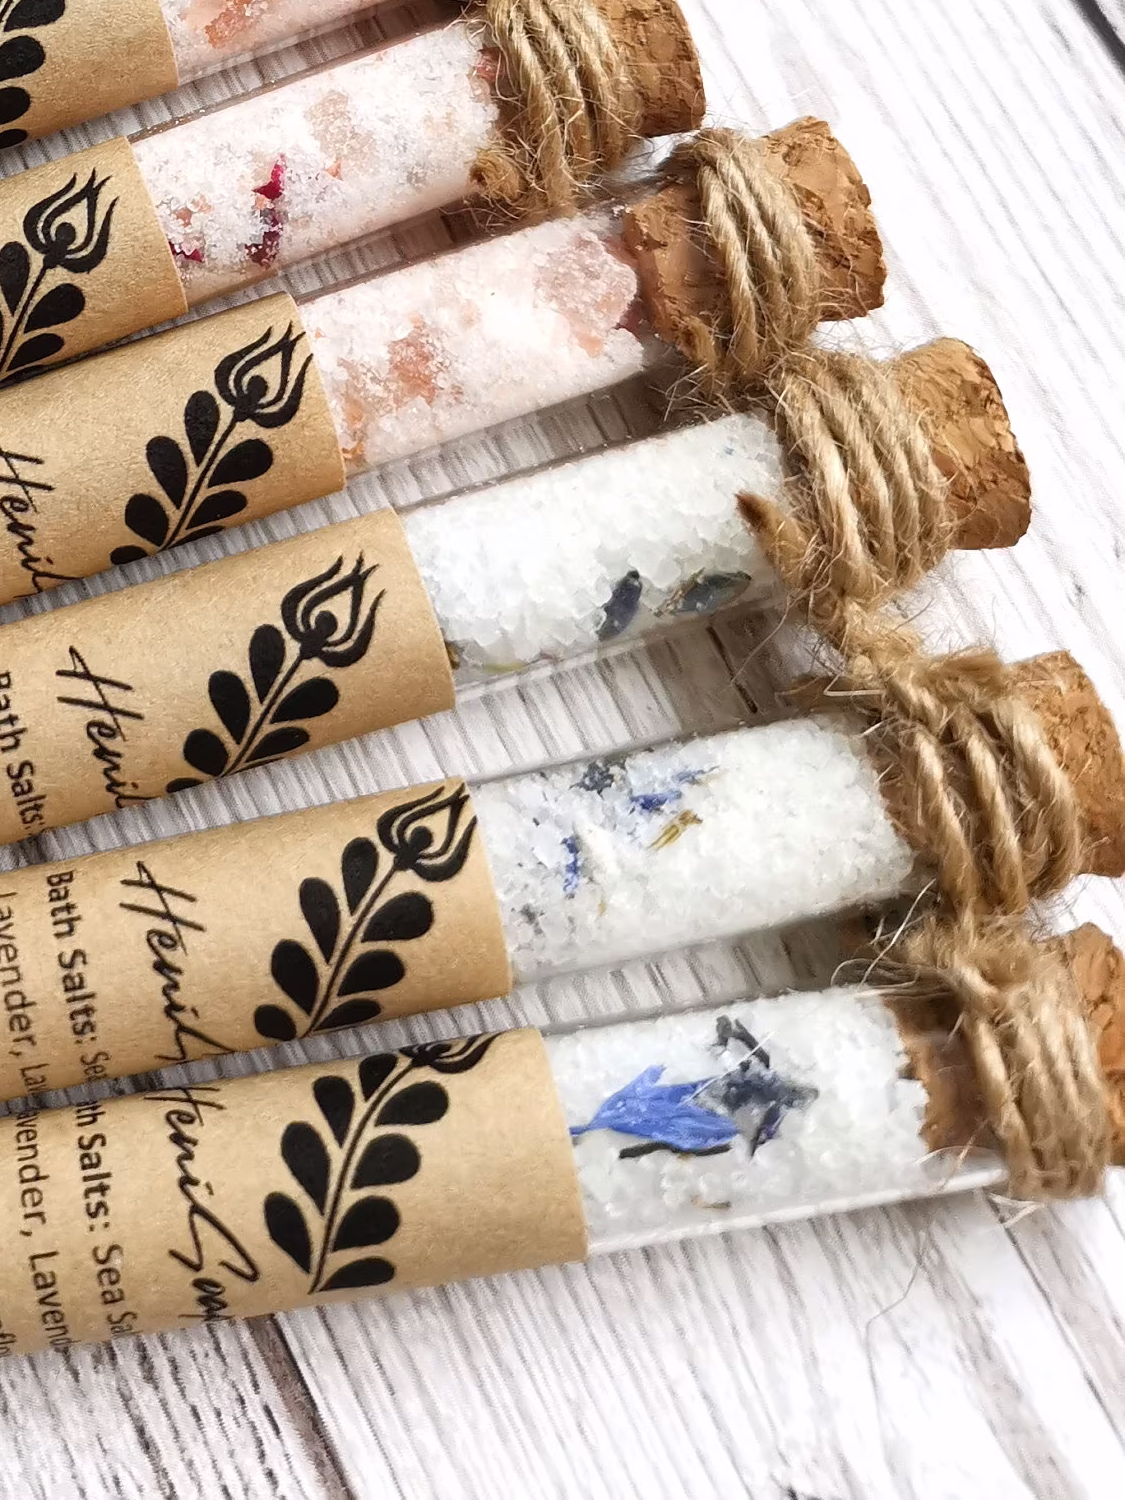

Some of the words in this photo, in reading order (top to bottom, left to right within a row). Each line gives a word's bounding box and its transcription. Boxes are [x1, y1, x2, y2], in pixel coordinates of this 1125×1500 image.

[6, 759, 47, 832] Salts:
[45, 870, 76, 939] Bath
[55, 948, 99, 1046] Salts:
[15, 1110, 47, 1239] avender,
[76, 1132, 115, 1234] Salts:
[93, 1243, 126, 1307] Sea
